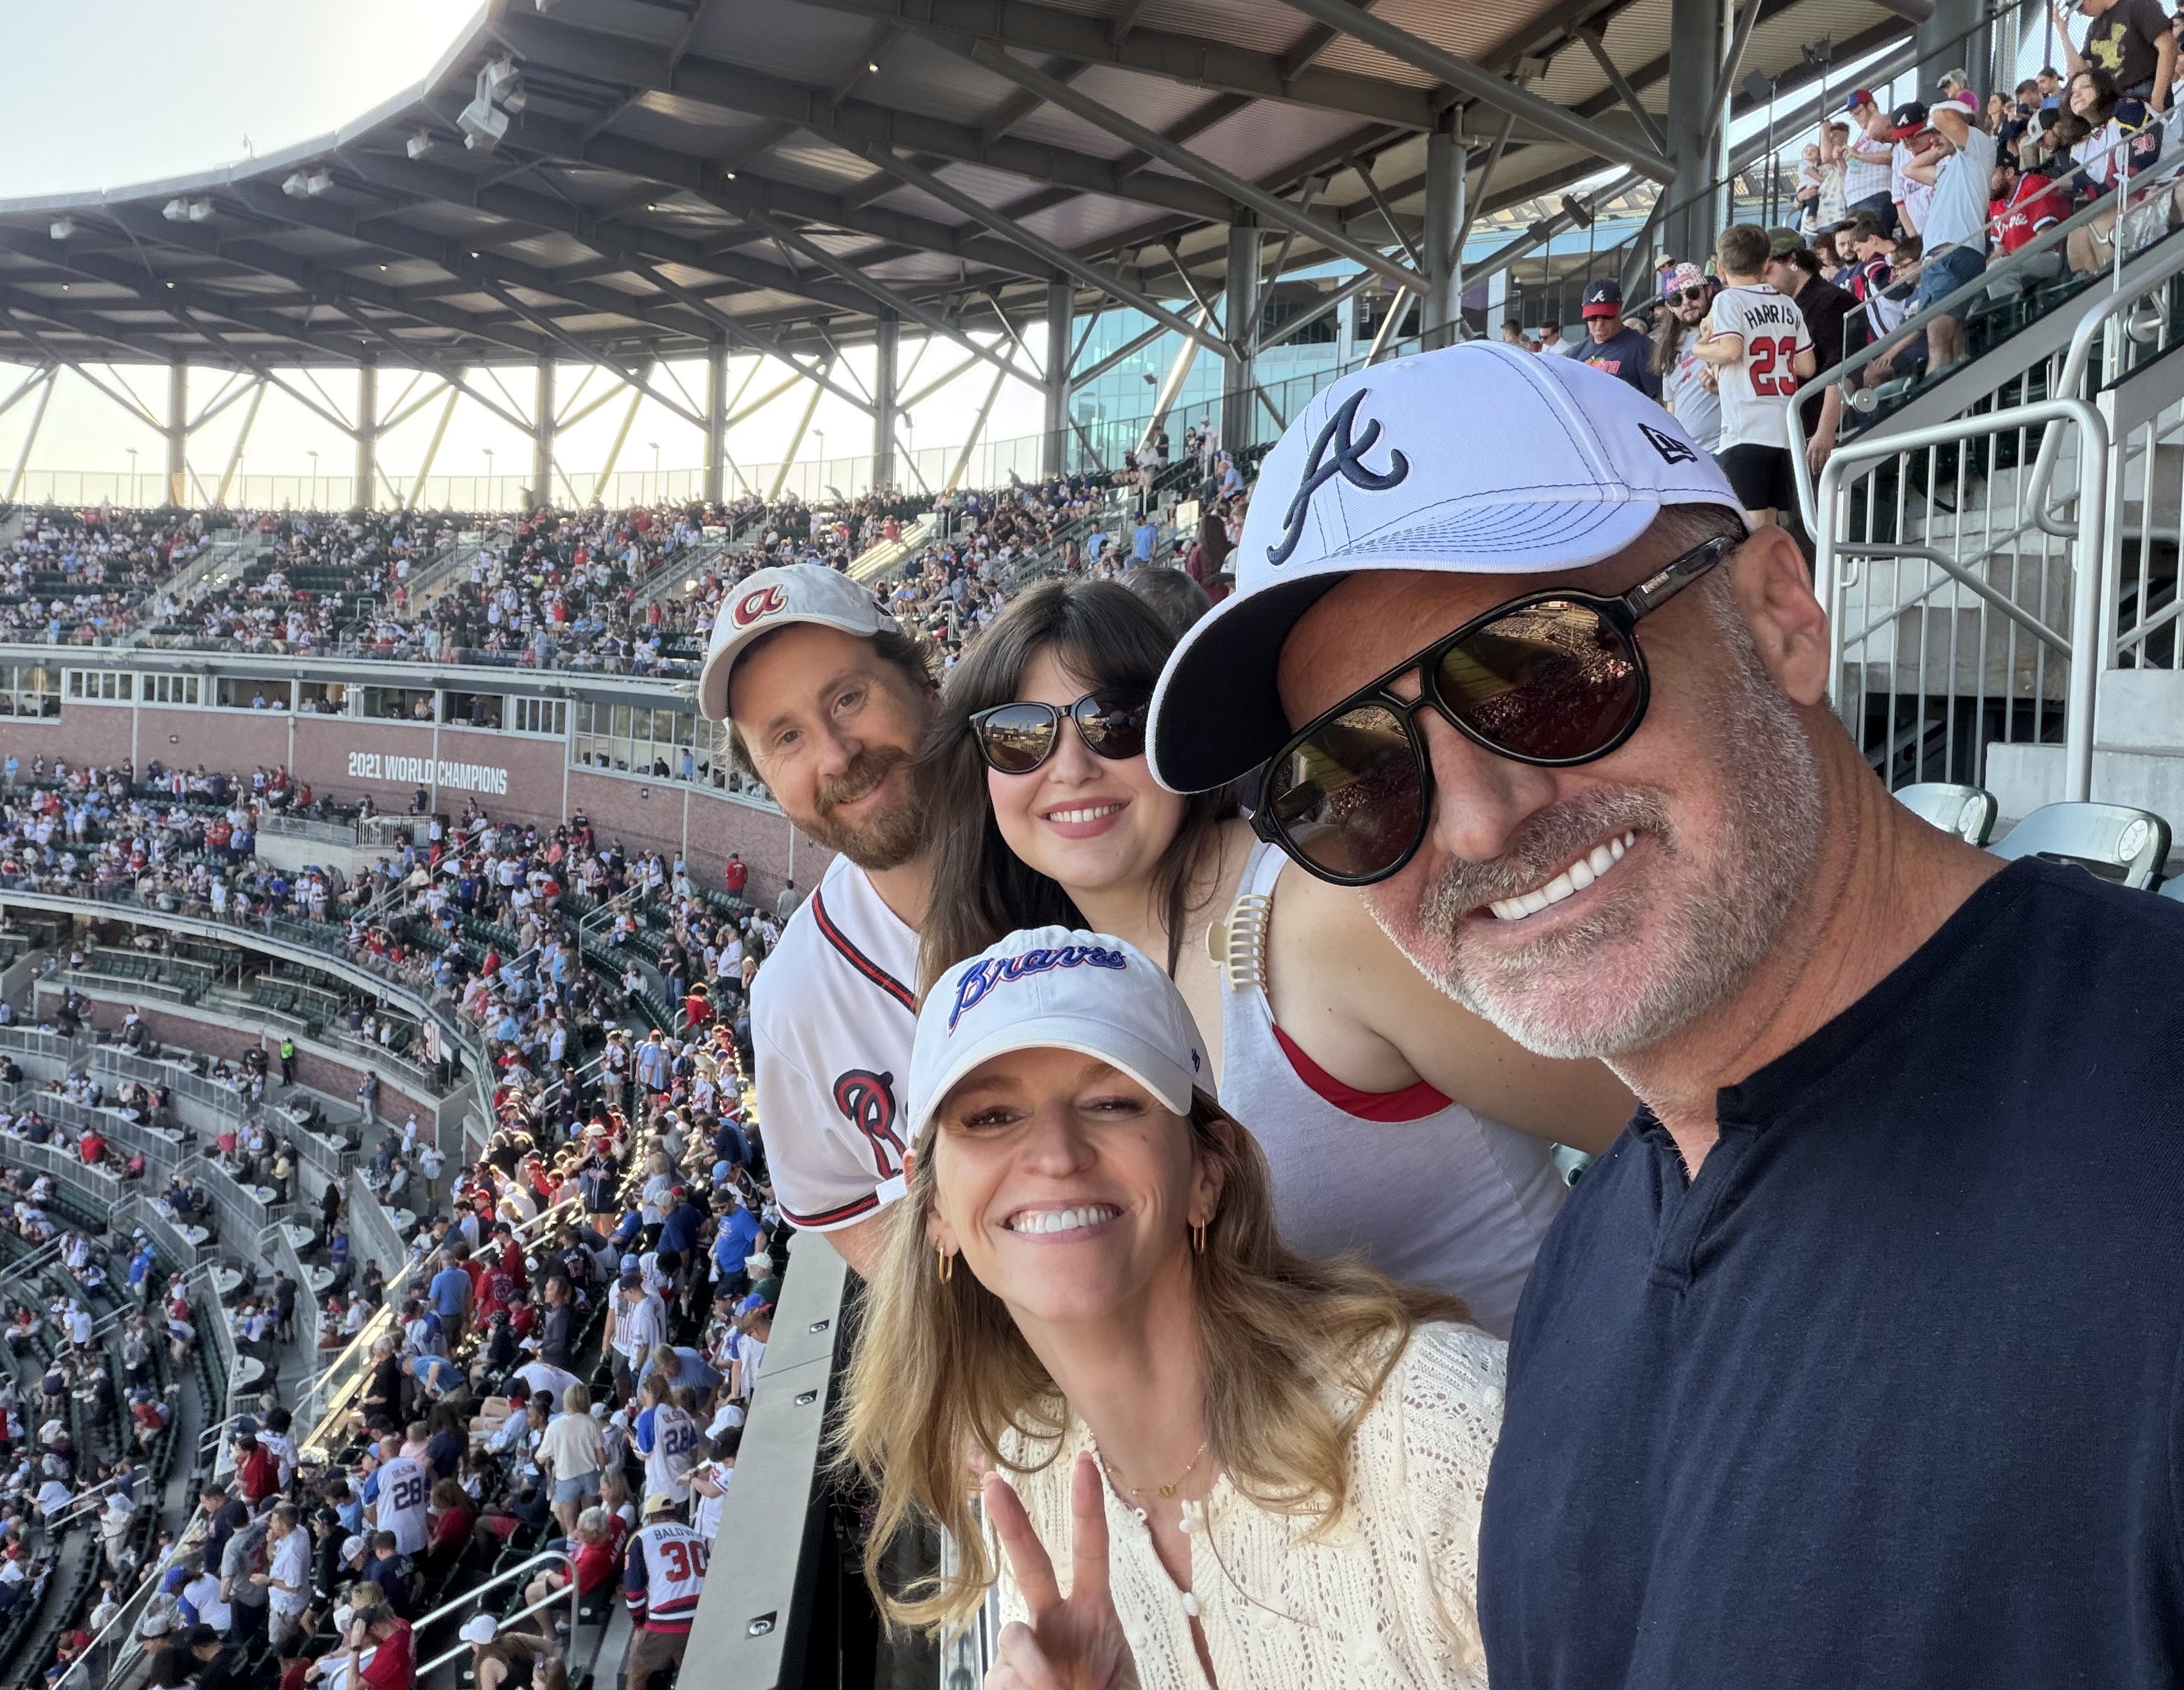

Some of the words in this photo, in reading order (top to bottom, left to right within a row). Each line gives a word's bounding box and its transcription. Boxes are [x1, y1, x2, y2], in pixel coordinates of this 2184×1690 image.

[1743, 304, 1795, 330] HARRIS
[1749, 335, 1798, 397] 23
[1266, 387, 1409, 566] A
[348, 752, 382, 779] 2021
[385, 755, 435, 784] WORLD
[438, 760, 508, 795] CHAMPIONS
[948, 945, 1127, 1039] Braves
[665, 1425, 690, 1456] 28
[392, 1476, 422, 1511] 28
[660, 1541, 709, 1583] 30
